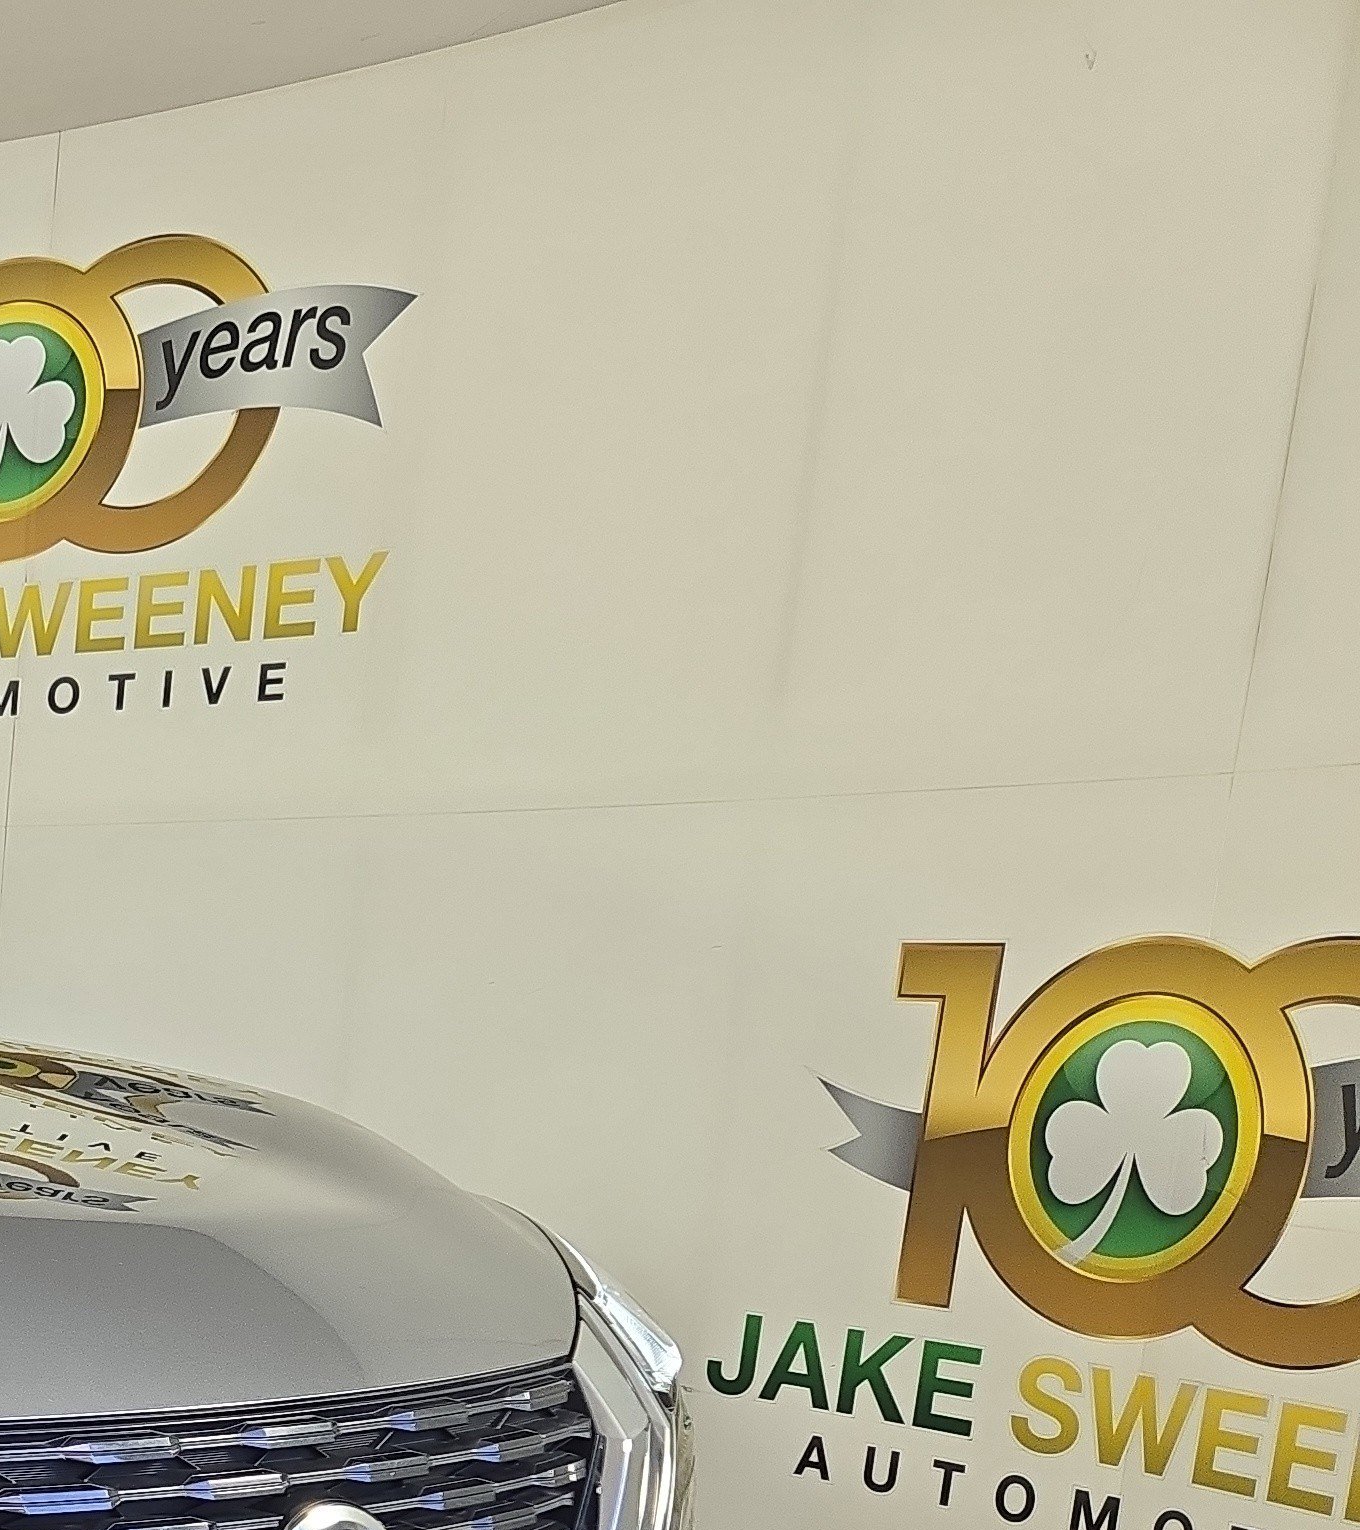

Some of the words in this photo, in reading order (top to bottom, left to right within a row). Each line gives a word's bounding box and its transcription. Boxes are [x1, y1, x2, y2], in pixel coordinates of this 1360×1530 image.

[156, 304, 351, 410] years
[706, 1313, 982, 1438] JAKE
[1010, 1355, 1360, 1524] SWEE
